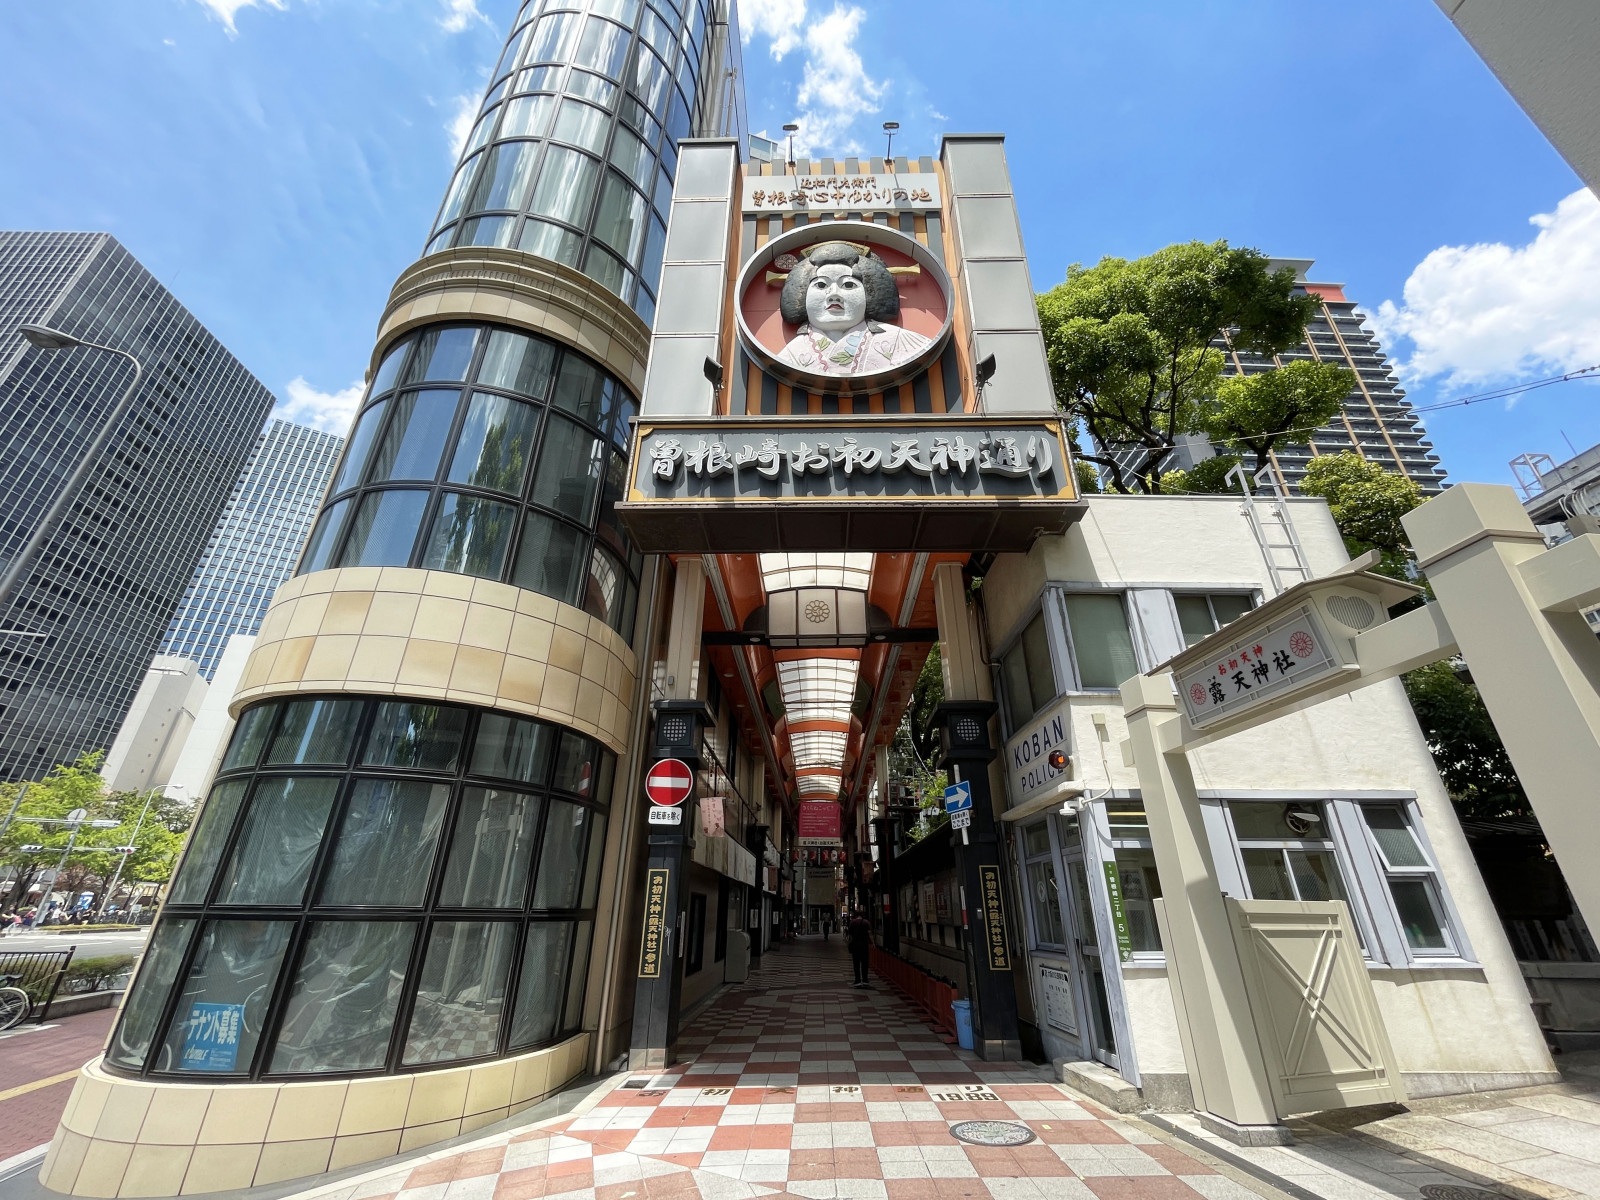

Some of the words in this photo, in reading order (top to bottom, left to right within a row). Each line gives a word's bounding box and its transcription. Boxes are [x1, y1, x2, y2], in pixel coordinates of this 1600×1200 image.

[800, 176, 877, 190] 近松門左衛門
[1217, 644, 1264, 676] お初天神
[1208, 649, 1296, 705] 露天神社
[1014, 715, 1064, 769] KOBAN
[650, 811, 681, 821] 自転車を除く
[952, 817, 970, 829] ここまで
[1118, 923, 1125, 933] 5
[187, 1009, 240, 1045] テナント募集
[931, 1092, 999, 1101] 1989
